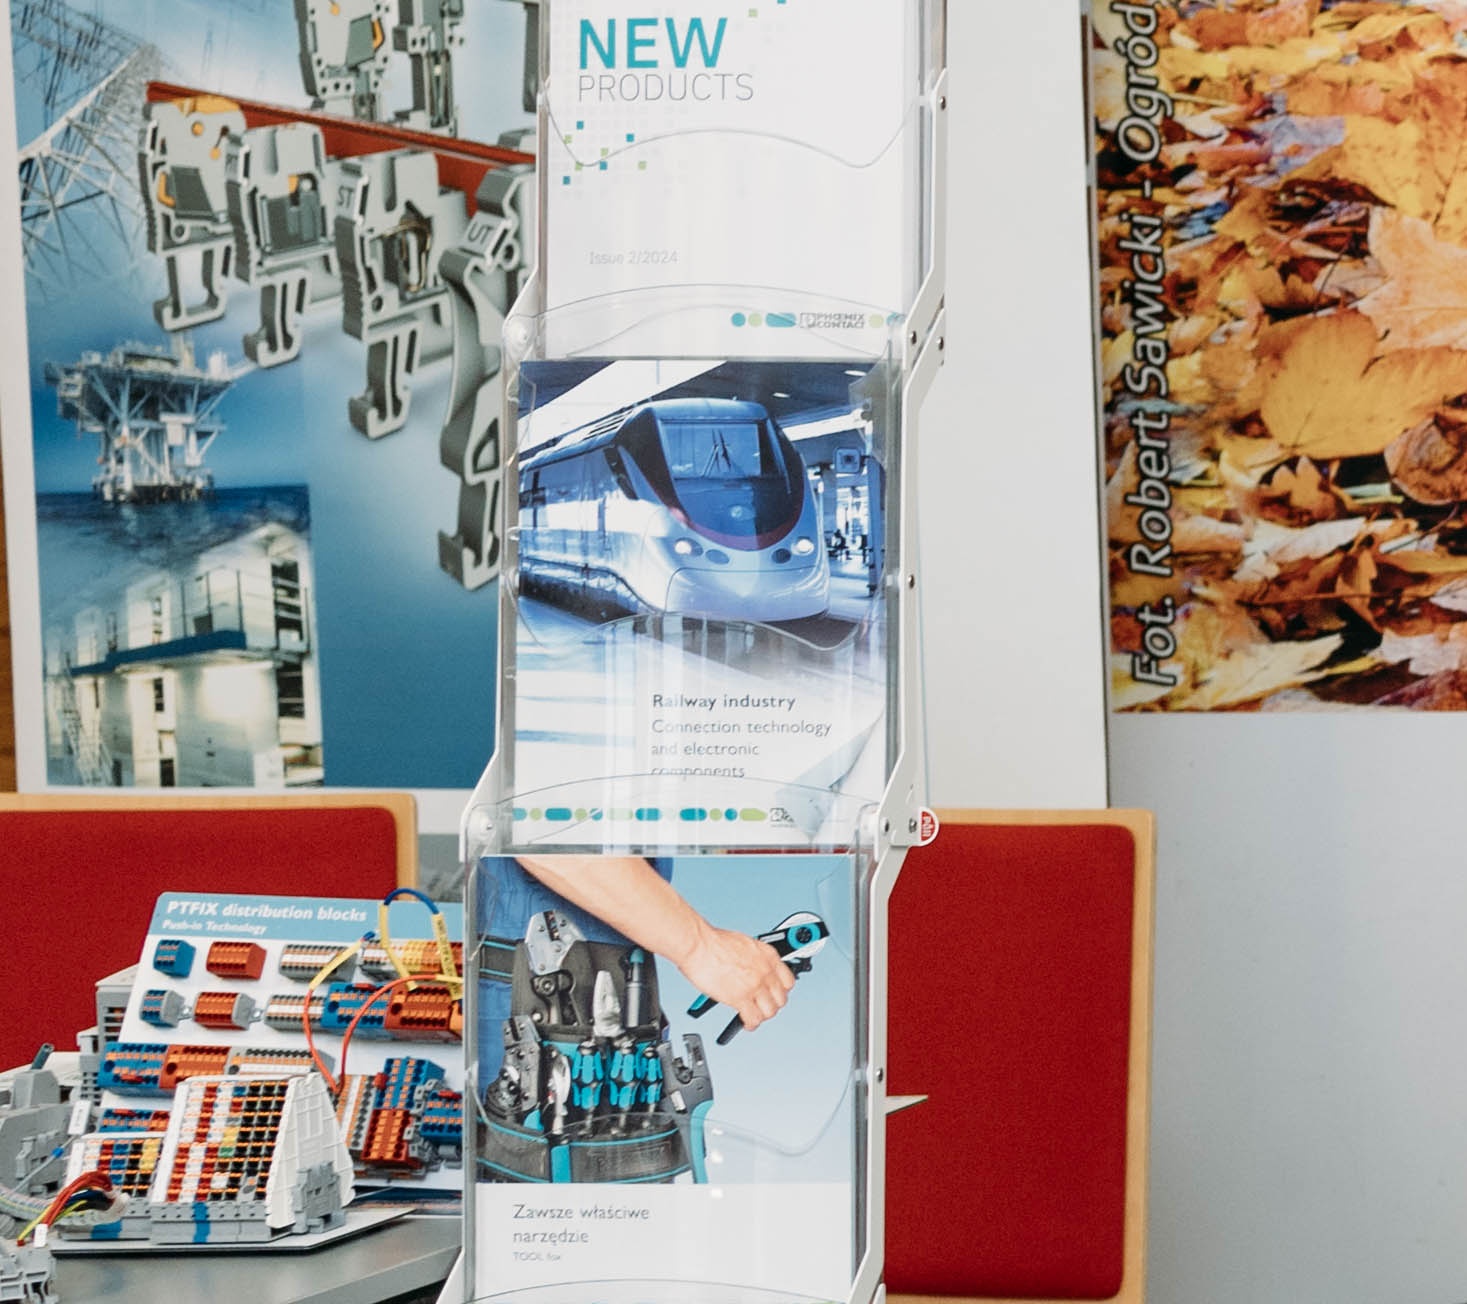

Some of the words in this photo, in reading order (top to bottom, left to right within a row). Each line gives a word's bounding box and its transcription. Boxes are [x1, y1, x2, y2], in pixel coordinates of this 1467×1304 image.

[578, 17, 728, 70] NEW
[577, 73, 755, 102] PRODUCTS
[1110, 0, 1172, 162] Ogród
[1119, 210, 1169, 398] Sawicki
[1127, 412, 1174, 577] Robert
[1134, 599, 1177, 687] Fot.
[651, 694, 717, 711] Railway
[723, 693, 796, 711] industry
[651, 719, 741, 734] Connection
[747, 719, 832, 737] technology
[651, 742, 678, 756] and
[683, 742, 760, 756] electronic
[166, 901, 218, 916] PTFIX
[222, 902, 313, 920] distribution
[316, 905, 367, 922] blocks
[205, 920, 268, 935] Technology
[512, 1204, 574, 1220] Zawsze
[580, 1203, 650, 1220] właściwe
[512, 1229, 590, 1245] narzędzie
